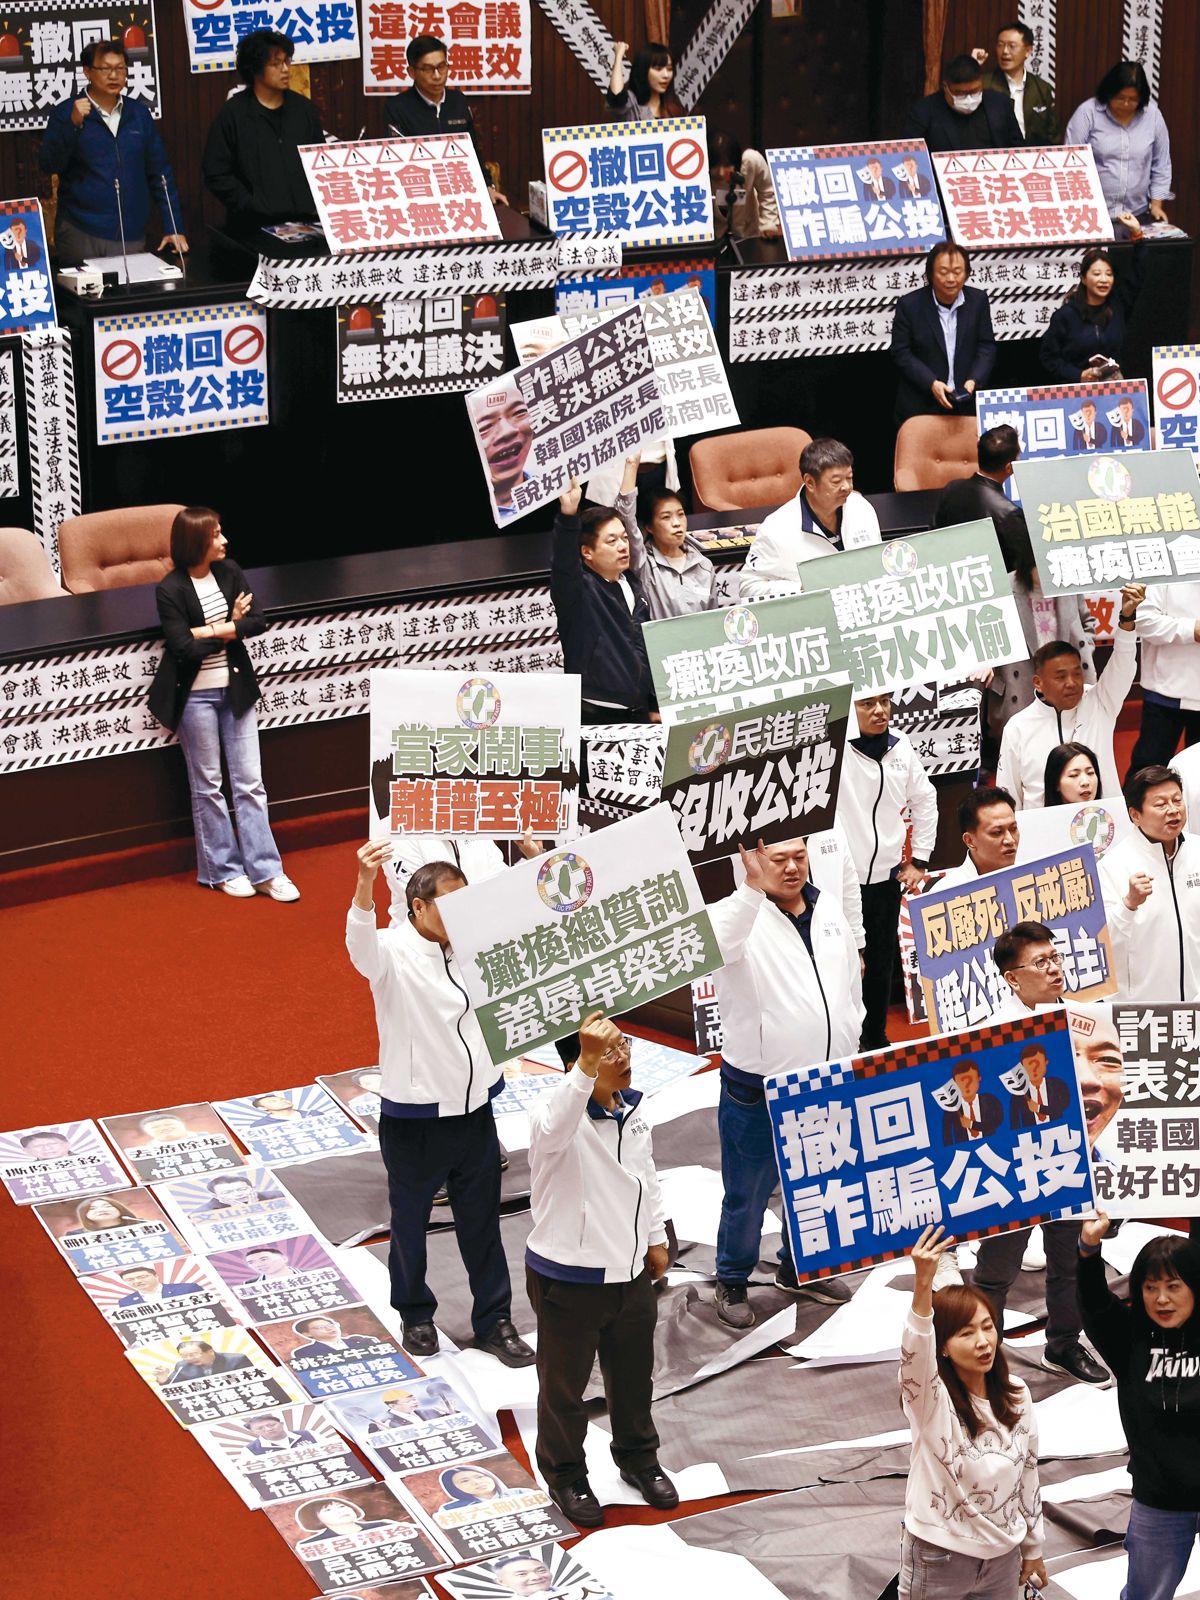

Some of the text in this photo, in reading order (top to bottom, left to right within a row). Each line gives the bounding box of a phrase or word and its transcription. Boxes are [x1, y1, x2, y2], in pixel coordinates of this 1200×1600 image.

[370, 2, 521, 39] 違法會議
[0, 62, 155, 113] 無效決
[371, 44, 522, 81] 表無效
[314, 161, 477, 206] 違法會議
[589, 143, 666, 188] 撤回
[777, 165, 857, 206] 撤回
[946, 171, 1094, 207] 違法會議
[328, 199, 488, 244] 表決無效
[553, 185, 708, 236] 空殼公投
[786, 198, 943, 248] 詐騙公投
[958, 204, 1103, 240] 表決無效
[331, 266, 403, 289] 決議無效
[412, 262, 483, 284] 違法會議
[733, 274, 877, 303] 違法會議 決議無效
[383, 296, 462, 336] 撤回
[733, 321, 877, 348] 違法會議 決議無效
[38, 336, 60, 408] 決議無效
[144, 330, 222, 375] 撤回
[342, 334, 503, 386] 無效議決
[519, 314, 644, 402] 詐騙公投
[104, 369, 265, 424] 空殼公投
[530, 346, 654, 433] 表決無效
[533, 382, 660, 467] 韓國瑜院長
[44, 416, 66, 493] 違法會議
[514, 406, 665, 510] 說好的協商呢
[1036, 492, 1200, 542] 治國無能
[831, 554, 995, 631] 癱瘓政府
[318, 622, 395, 650] 違法會議
[403, 611, 480, 638] 違法會議
[842, 606, 1012, 692] 薪水小偷
[51, 661, 131, 692] 決議無效
[662, 626, 831, 700] 癱瘓政府
[52, 715, 132, 747] 決議無效
[391, 723, 570, 776] 當家鬧事!
[729, 703, 831, 761] 民進黨
[389, 780, 568, 833] 離譜至極!
[673, 741, 838, 853] 沒收公投
[475, 868, 690, 998] 癱瘓總質詢
[921, 861, 1095, 958] 反廢死! 反戒嚴!
[494, 922, 706, 1051] 羞辱卓榮泰
[780, 1082, 931, 1182] 撤回
[793, 1128, 1088, 1257] 詐騙公投
[317, 1368, 407, 1393] 怕罷免
[188, 1396, 279, 1422] 怕罷免
[399, 1442, 486, 1470] 怕罷免
[269, 1470, 360, 1498] 怕罷免
[467, 1524, 562, 1553] 怕罷免
[329, 1557, 425, 1585] 怕罷免
